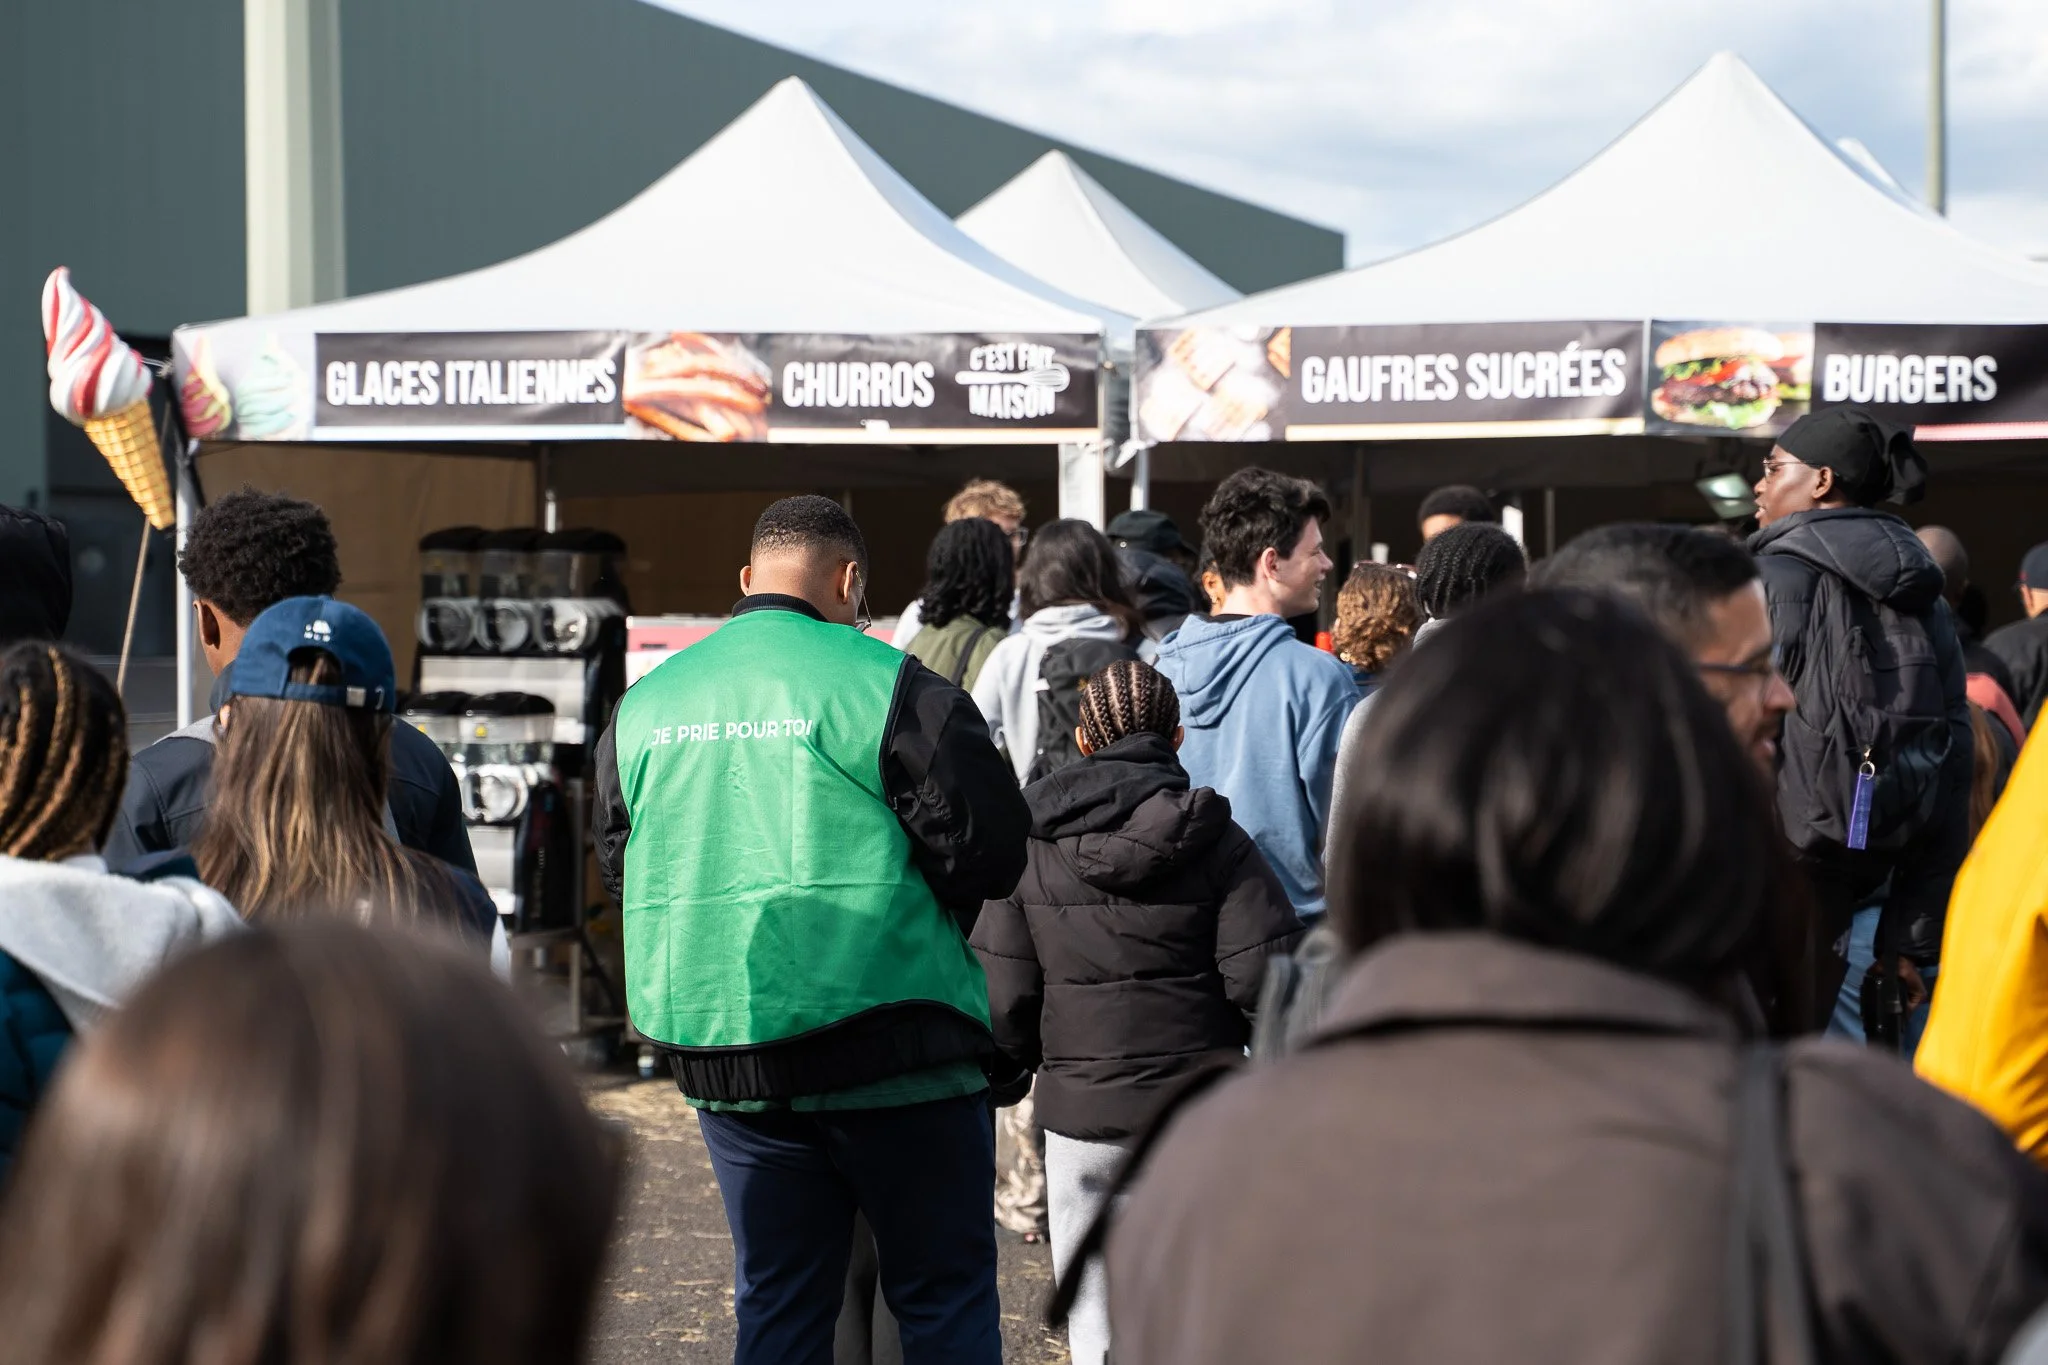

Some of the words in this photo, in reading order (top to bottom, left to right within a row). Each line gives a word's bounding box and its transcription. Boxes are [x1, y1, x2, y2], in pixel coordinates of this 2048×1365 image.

[969, 343, 1016, 371] C'EST
[1301, 354, 1459, 403] GAUFRES
[1465, 341, 1626, 400] SUCRÉES
[1824, 354, 1997, 403] BURGERS
[326, 360, 440, 405] GLACES
[445, 358, 616, 404] ITALIENNES
[783, 361, 934, 407] CHURROS
[969, 384, 1056, 419] MAISON
[651, 727, 672, 745] JE
[677, 723, 720, 743] PRIE
[725, 720, 778, 740] POUR
[783, 719, 812, 737] TOI
